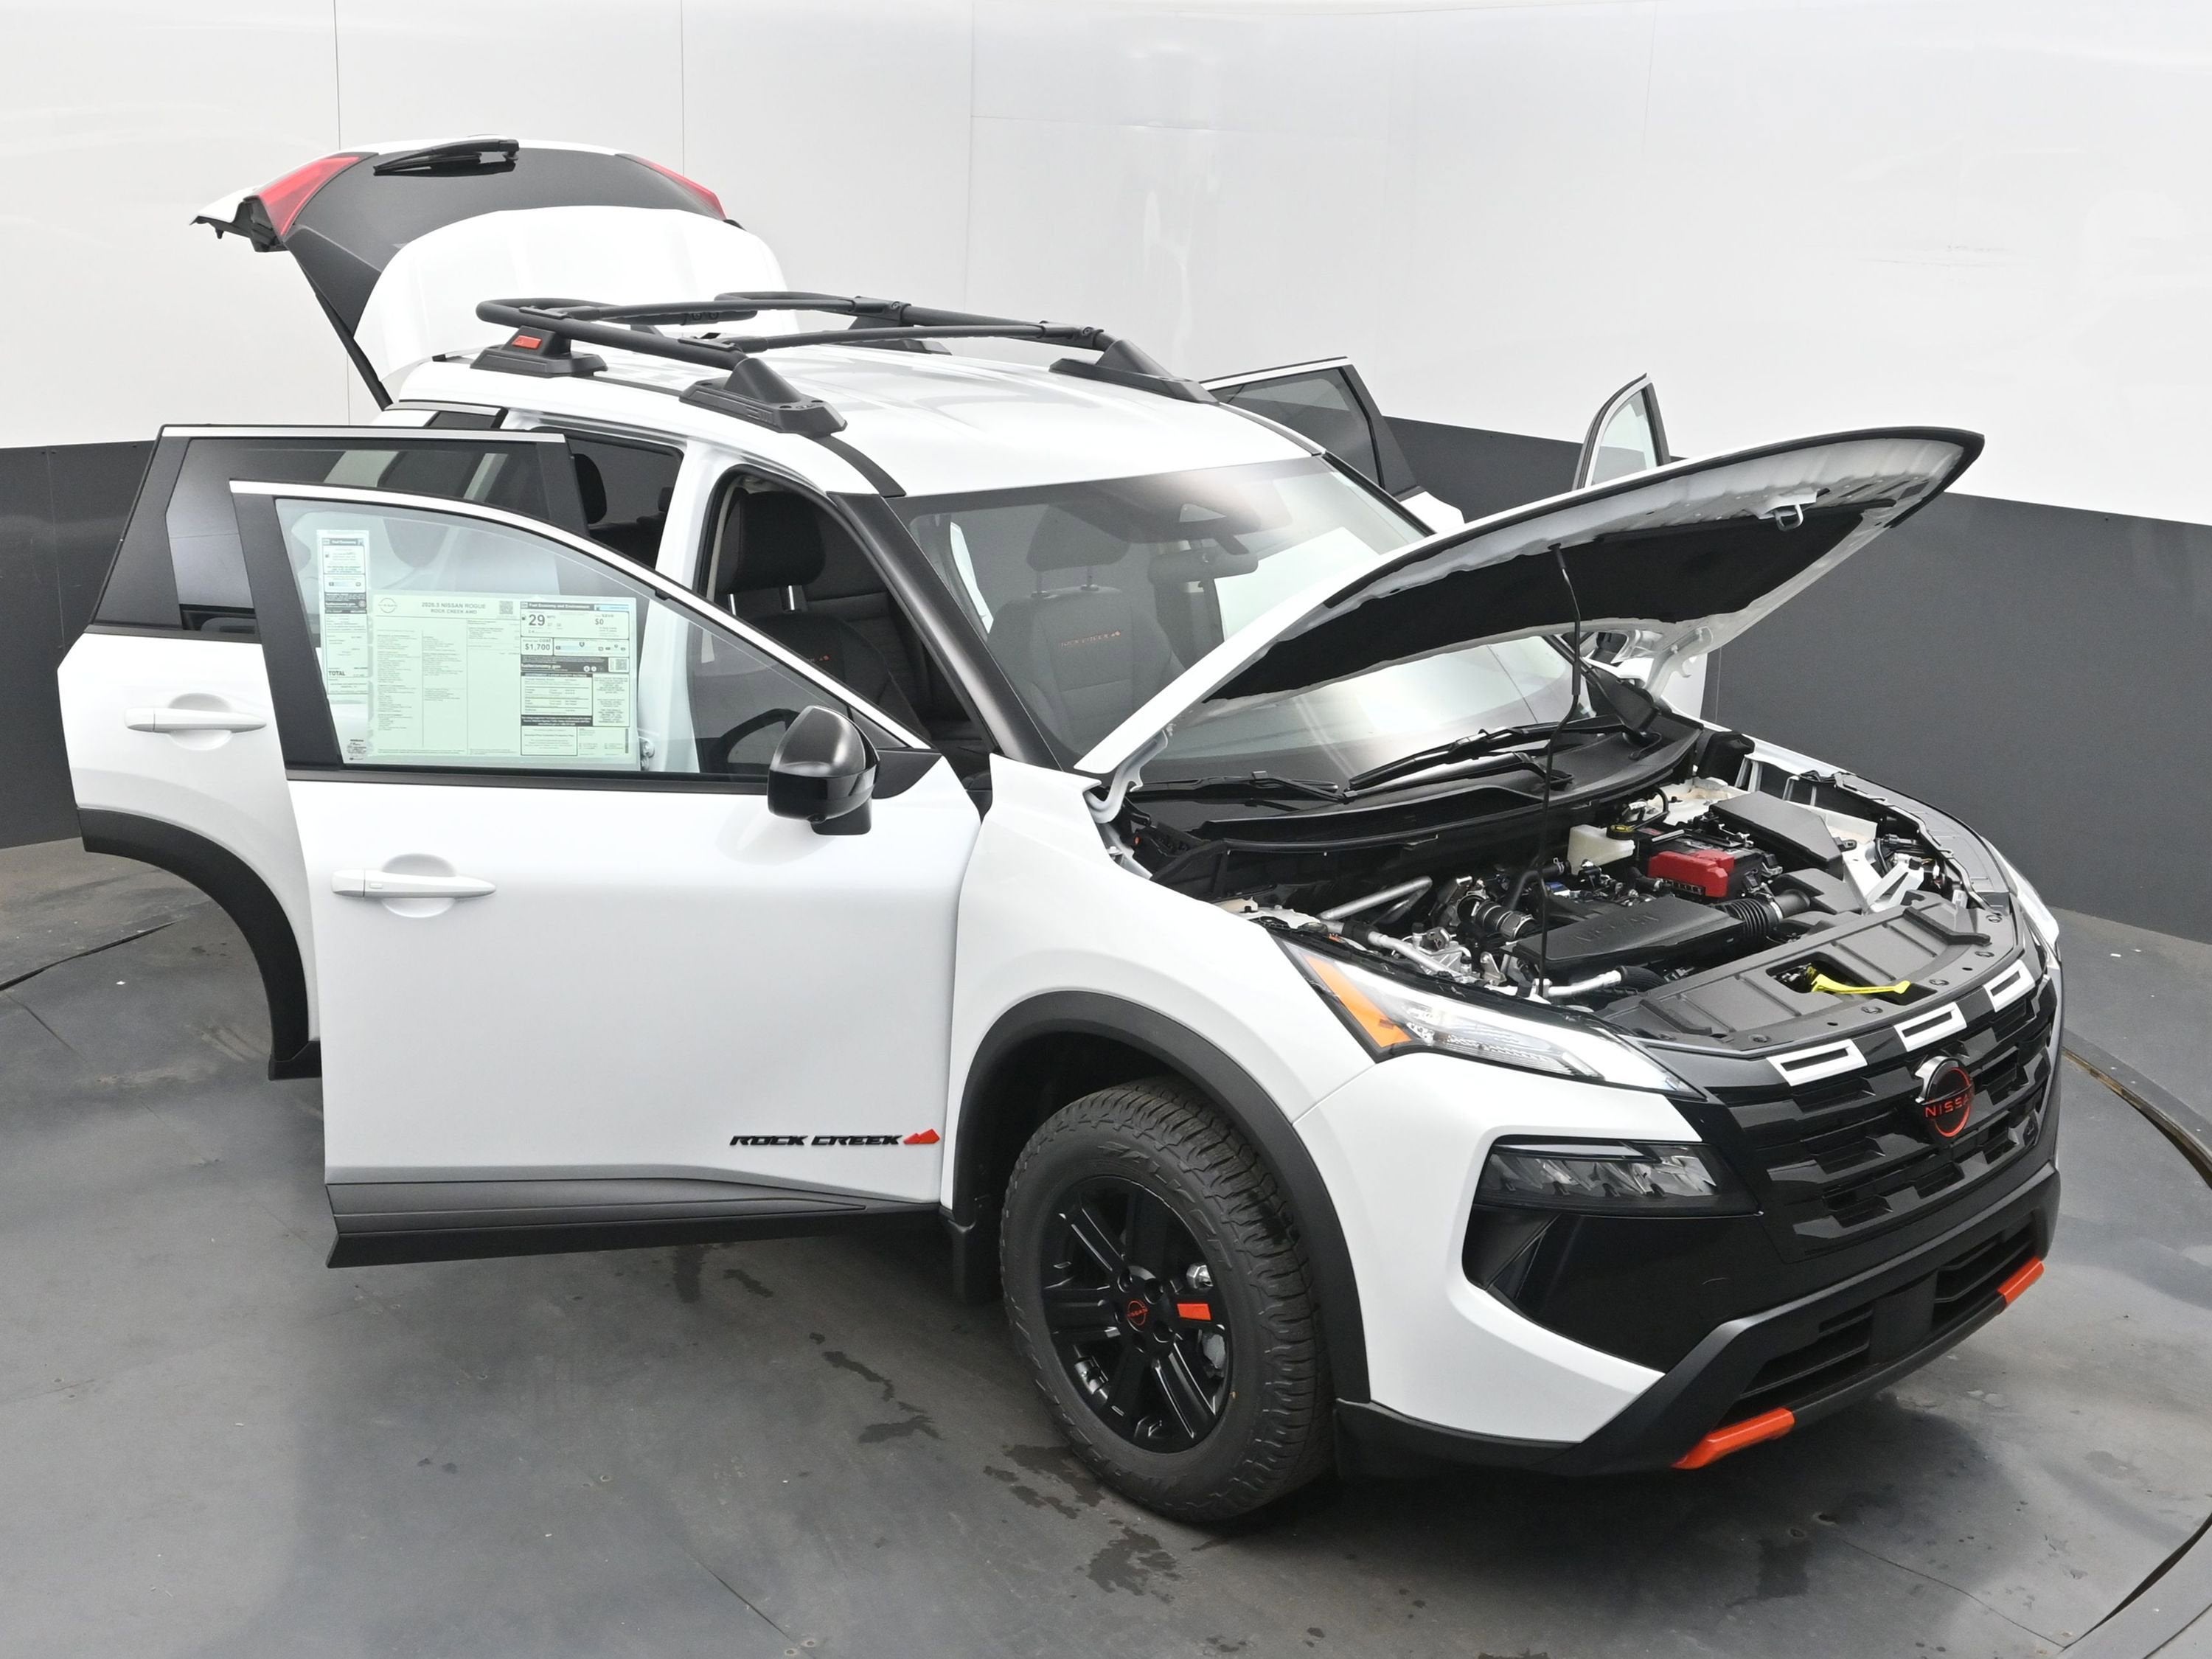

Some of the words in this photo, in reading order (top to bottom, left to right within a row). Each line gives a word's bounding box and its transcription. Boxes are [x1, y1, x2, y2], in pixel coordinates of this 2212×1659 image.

[528, 613, 546, 626] 29
[524, 643, 551, 652] $1,700
[1924, 1093, 1971, 1118] NISSA
[729, 1134, 809, 1147] ROCK
[810, 1134, 904, 1147] CREEK
